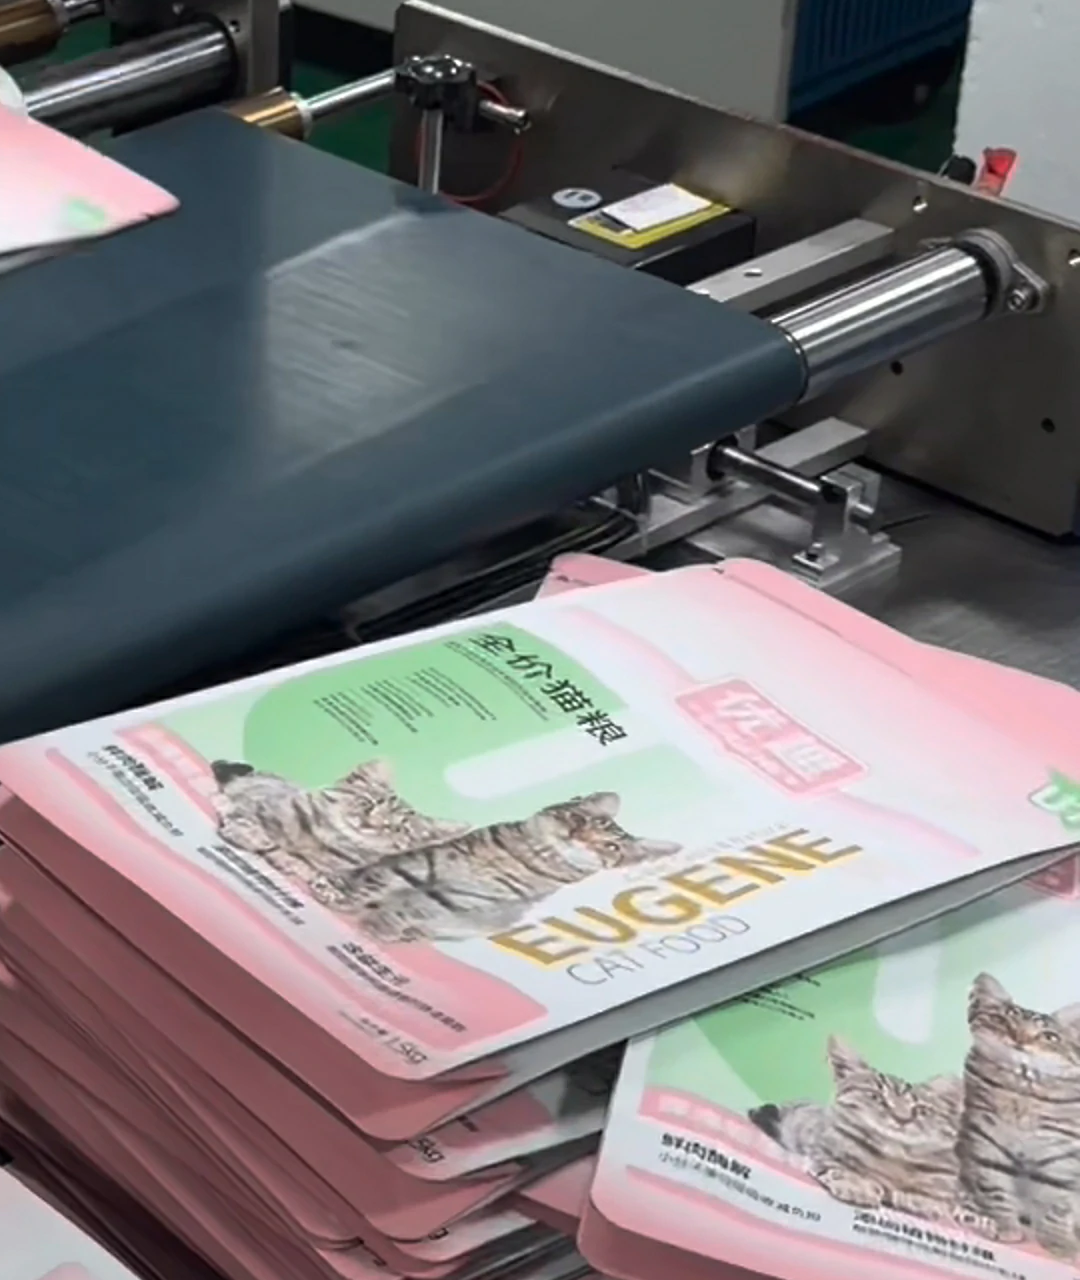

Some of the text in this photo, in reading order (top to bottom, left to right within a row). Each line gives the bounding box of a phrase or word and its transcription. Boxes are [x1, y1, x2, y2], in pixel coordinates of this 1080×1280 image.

[468, 632, 628, 747] 全价猫粮
[487, 827, 863, 966] EUGENE
[566, 914, 751, 986] CAT FOOD
